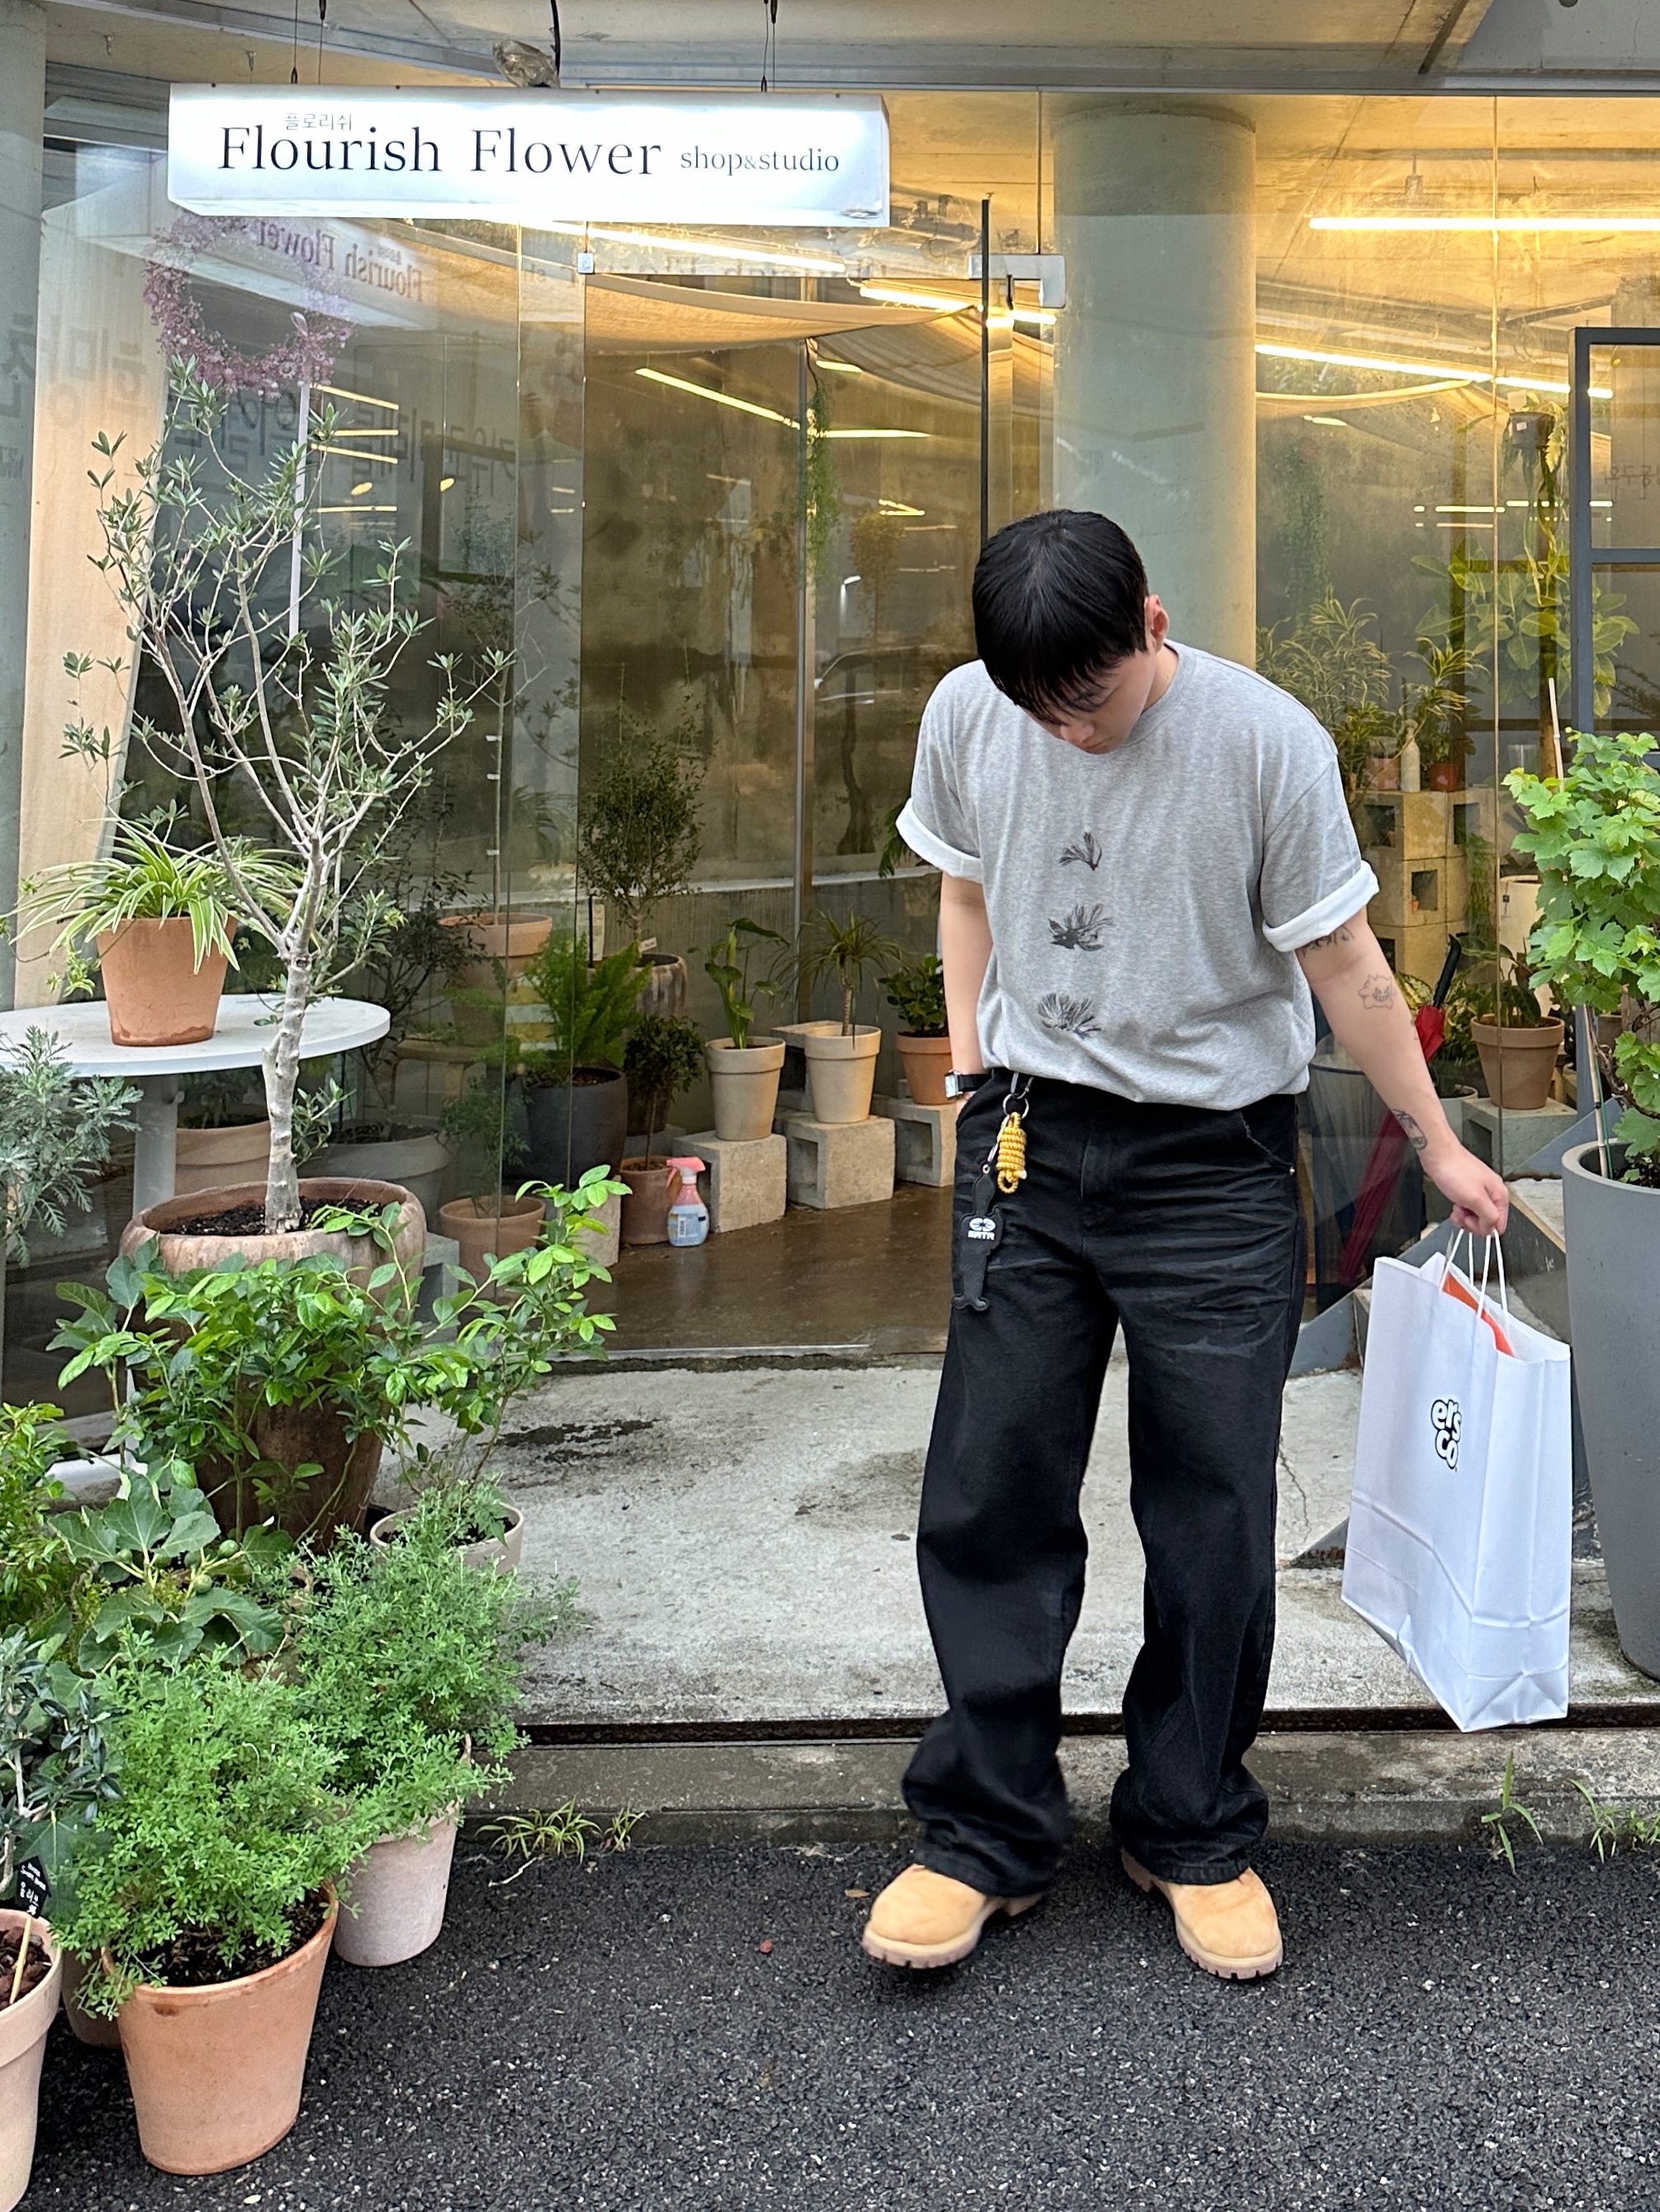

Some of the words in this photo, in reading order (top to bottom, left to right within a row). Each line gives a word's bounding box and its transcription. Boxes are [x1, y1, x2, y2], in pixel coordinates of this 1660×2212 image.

[284, 113, 352, 130] 플로리쉬
[217, 124, 442, 172] Flourish
[470, 127, 661, 175] Flower
[680, 145, 840, 176] shop&studio
